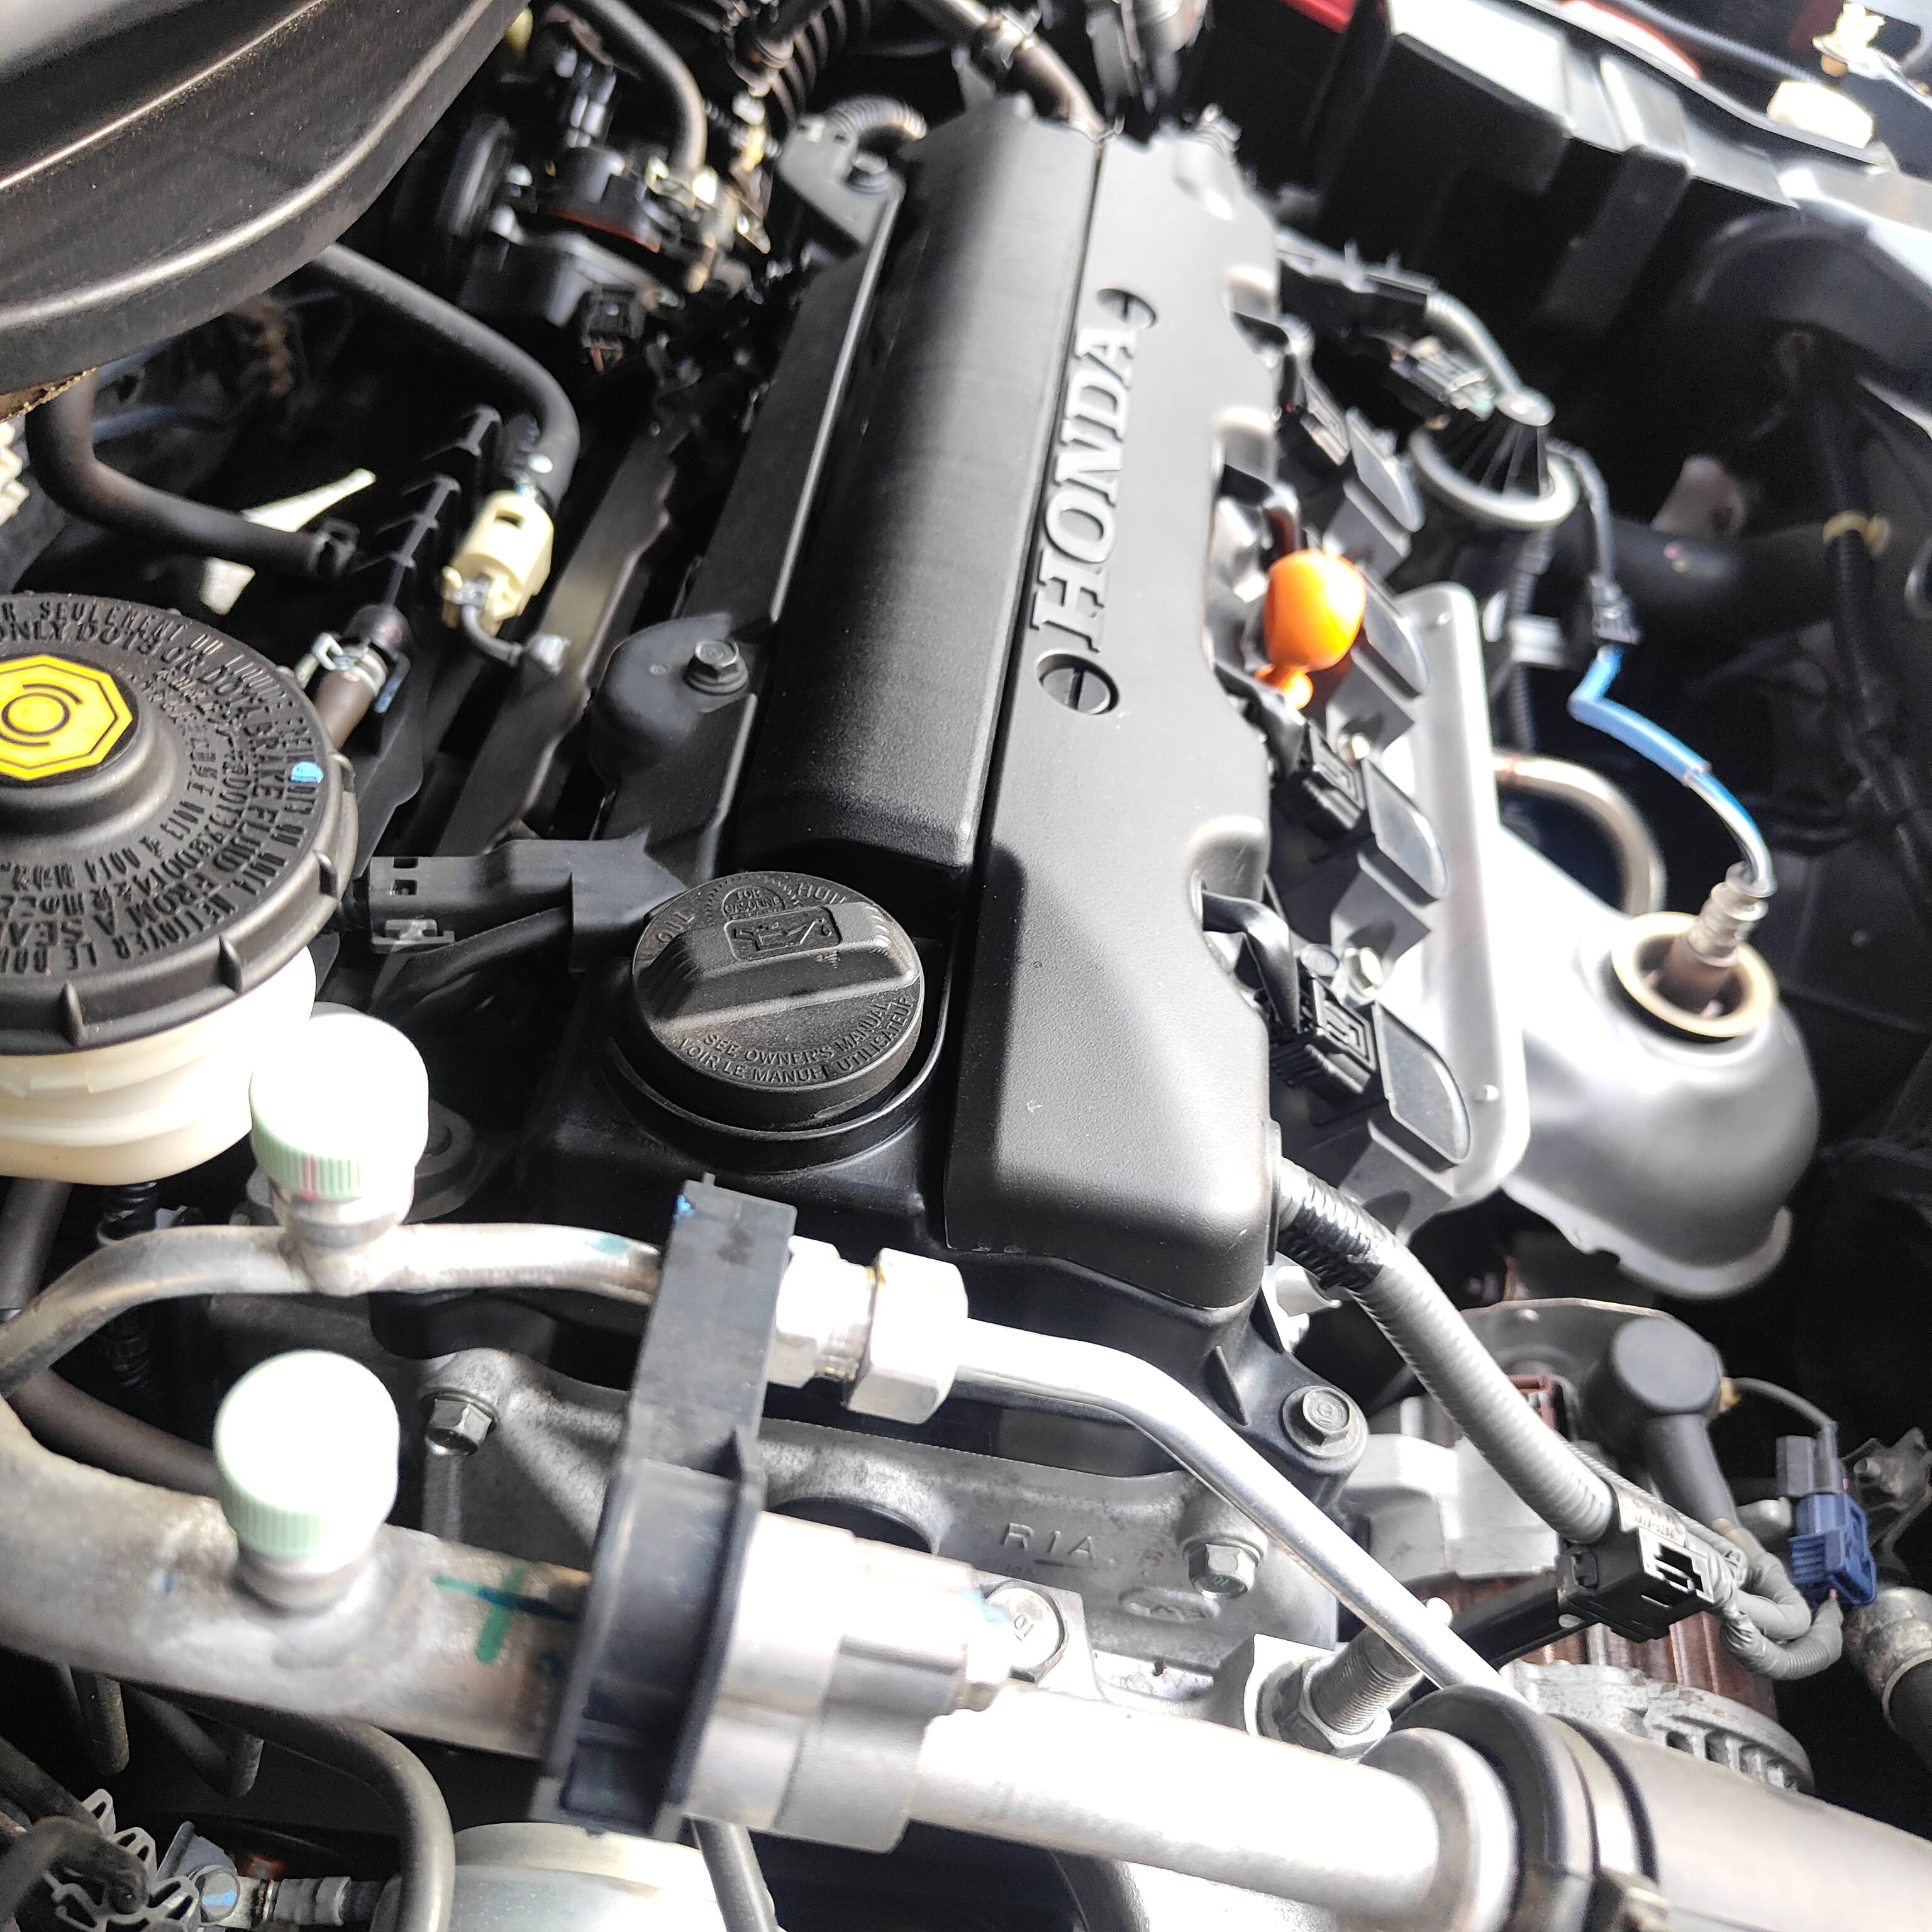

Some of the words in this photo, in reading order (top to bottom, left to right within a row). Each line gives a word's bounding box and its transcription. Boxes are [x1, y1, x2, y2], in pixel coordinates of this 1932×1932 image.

[1030, 327, 1137, 653] HONDA
[4, 918, 83, 948] SEA
[657, 911, 695, 943] OIL
[679, 1038, 719, 1071] VOIR
[723, 1061, 748, 1079] LE
[836, 997, 914, 1071] UTILISATEUR
[704, 1034, 741, 1058] SEE
[745, 1046, 835, 1066] OWNER'S
[834, 1002, 892, 1052] MANUAL
